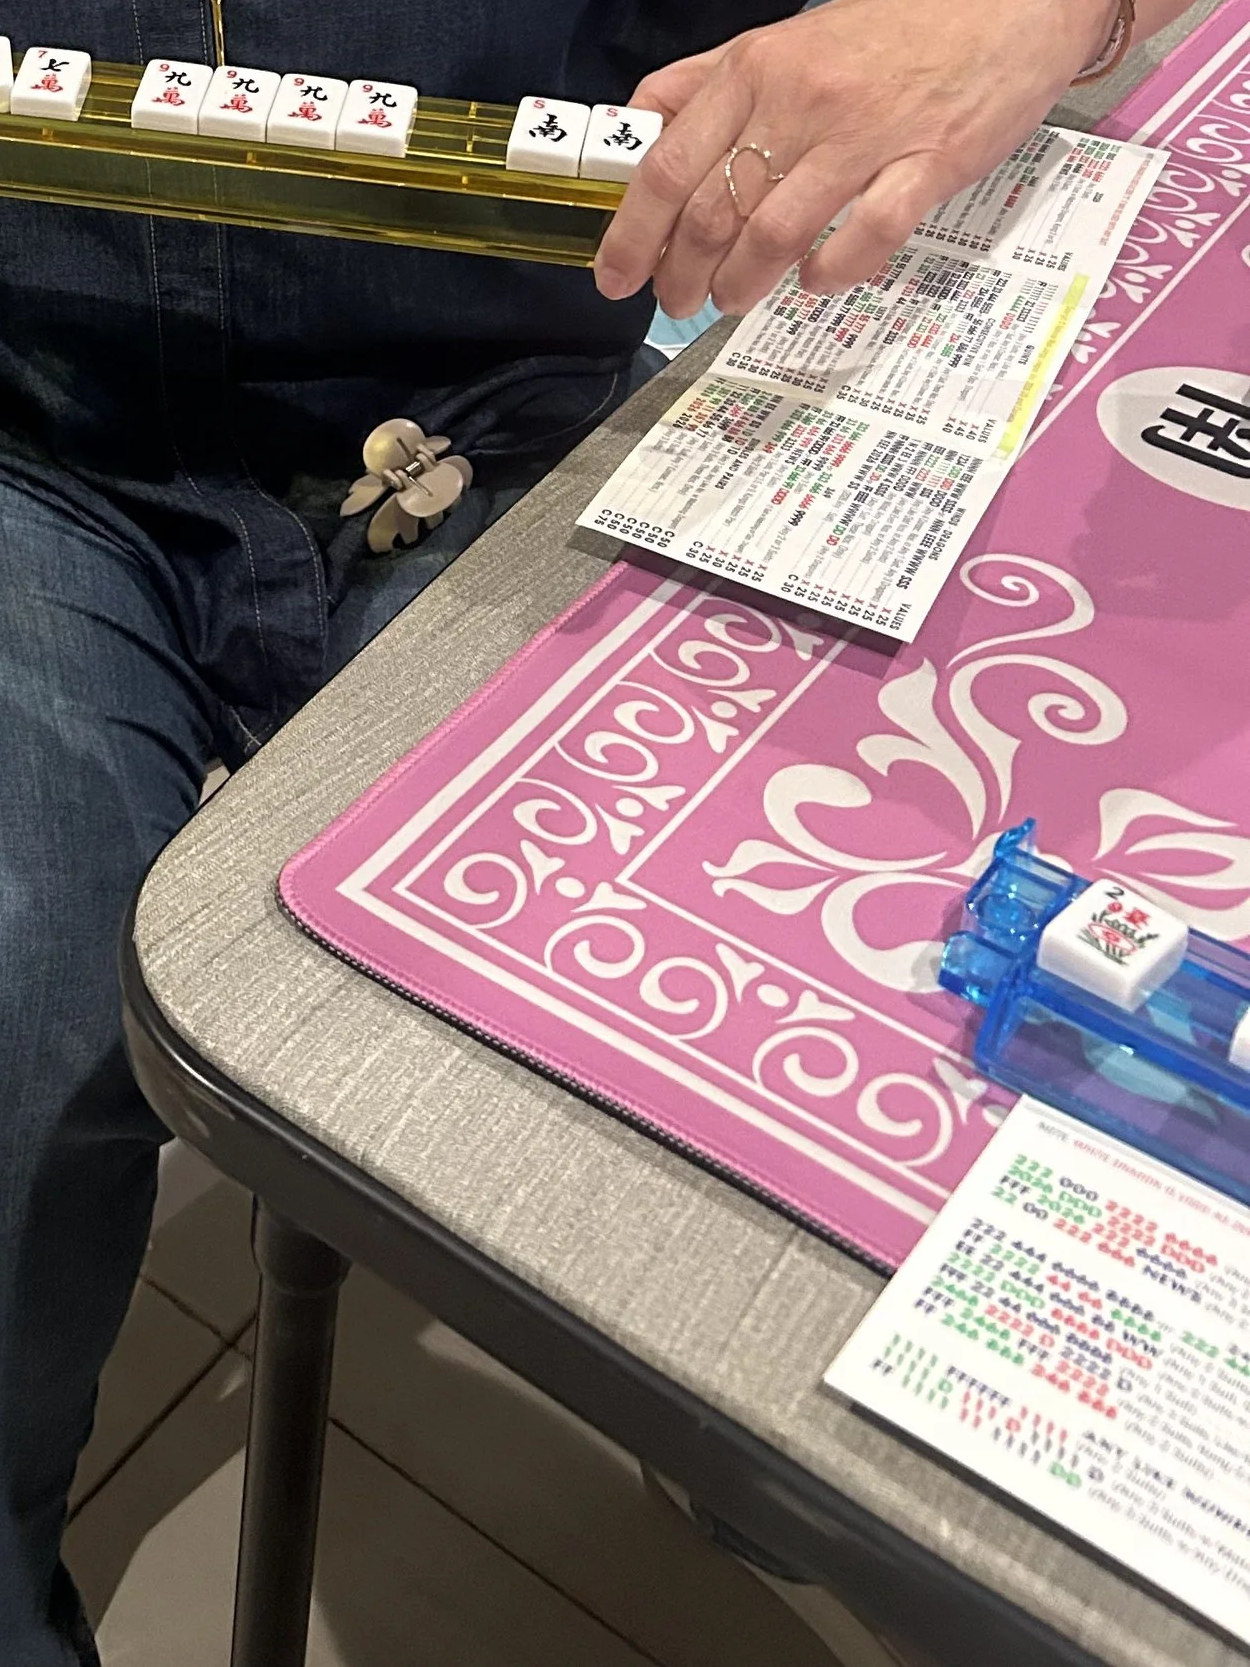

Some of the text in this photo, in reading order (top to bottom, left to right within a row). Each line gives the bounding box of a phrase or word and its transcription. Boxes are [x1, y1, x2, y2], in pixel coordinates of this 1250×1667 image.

[38, 50, 47, 58] 7
[160, 64, 169, 72] 9
[227, 71, 236, 79] 9
[294, 78, 304, 87] 9
[362, 84, 372, 93] 9
[534, 100, 545, 109] S
[607, 108, 618, 117] S
[529, 114, 567, 142] 南
[604, 122, 642, 150] 南
[758, 367, 770, 376] 25
[802, 380, 814, 389] 25
[813, 383, 825, 393] 25
[835, 391, 847, 400] 35
[847, 394, 858, 403] 25
[858, 398, 869, 406] 30
[869, 401, 881, 410] 25
[881, 404, 893, 414] 25
[672, 412, 692, 429] 2026
[904, 411, 915, 421] 25
[915, 415, 927, 424] 25
[702, 420, 715, 429] 66
[941, 422, 953, 433] 40
[953, 426, 965, 436] 45
[965, 430, 976, 440] 40
[977, 418, 996, 443] VALUES
[784, 447, 803, 465] NEWS
[728, 458, 743, 471] AND
[714, 471, 733, 489] PAIRS
[847, 481, 860, 489] SS
[593, 515, 608, 525] 75
[786, 509, 805, 526] 9999
[606, 519, 620, 529] 50
[618, 523, 633, 534] 50
[631, 527, 645, 538] 50
[643, 525, 662, 543] C 50
[656, 537, 670, 548] 50
[929, 529, 952, 560] DRAGONS
[685, 547, 699, 558] 30
[698, 552, 712, 563] 25
[711, 557, 725, 567] 30
[724, 561, 738, 572] 25
[737, 566, 751, 577] 25
[750, 571, 764, 582] 25
[787, 573, 798, 581] C
[779, 581, 793, 592] 30
[895, 575, 911, 589] SSS
[793, 586, 806, 597] 25
[806, 591, 820, 602] 25
[820, 595, 834, 606] 25
[833, 600, 847, 611] 25
[847, 605, 861, 616] 25
[861, 609, 874, 621] 25
[889, 602, 911, 630] VALUES
[874, 614, 888, 625] 25
[1105, 887, 1124, 900] 2
[1013, 1153, 1054, 1178] 222
[1102, 1199, 1160, 1233] 2222
[1051, 1216, 1095, 1244] 222
